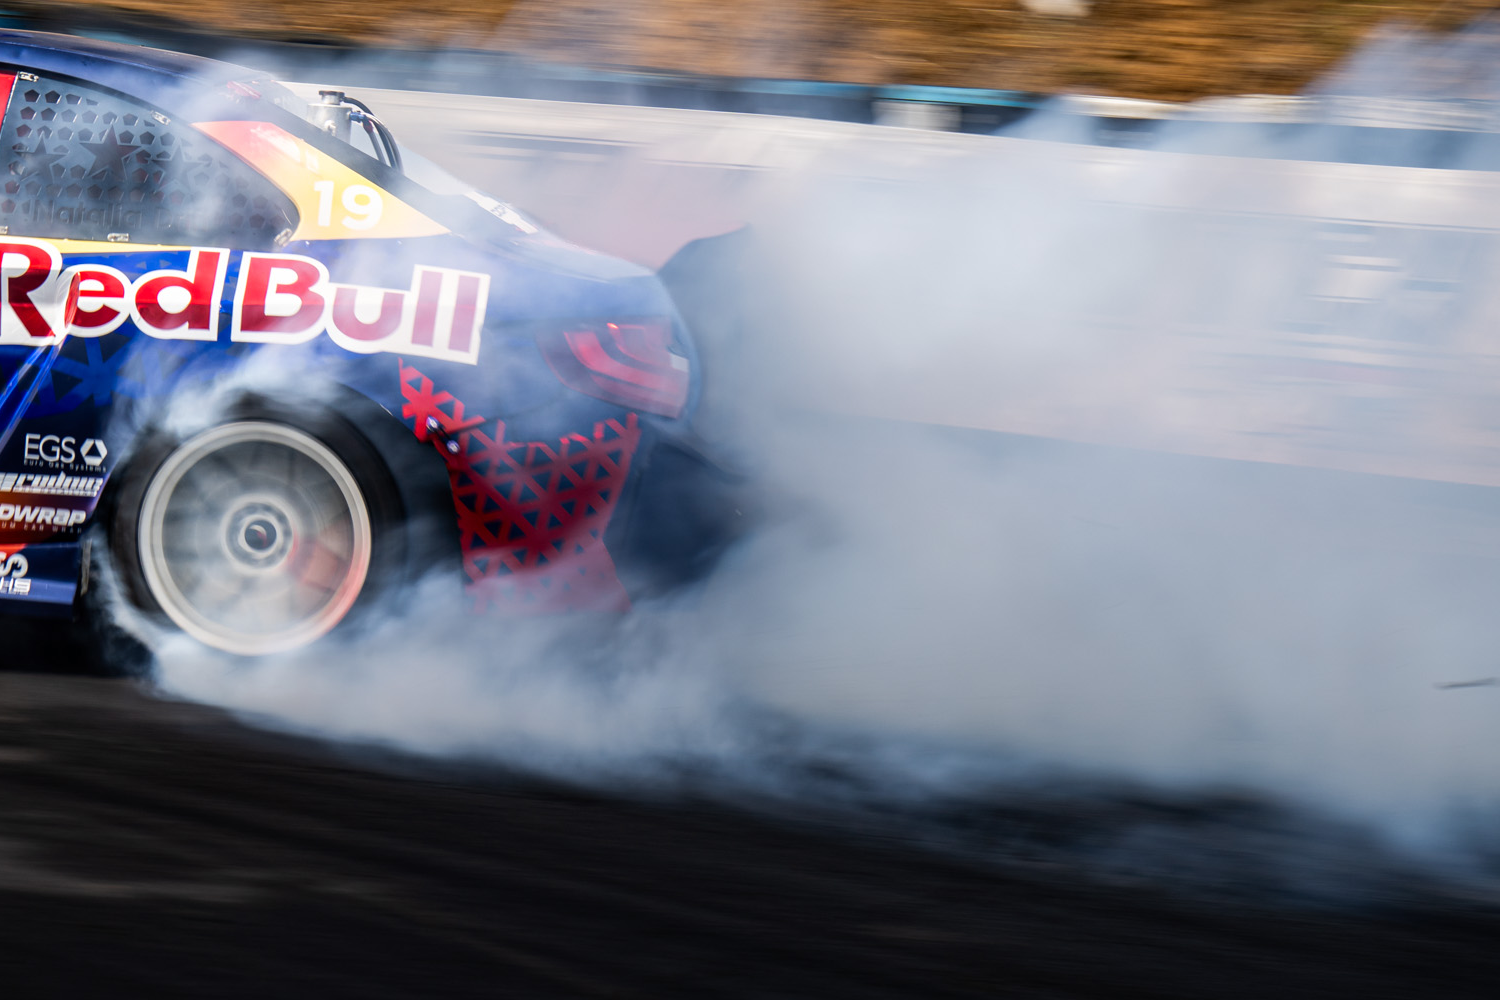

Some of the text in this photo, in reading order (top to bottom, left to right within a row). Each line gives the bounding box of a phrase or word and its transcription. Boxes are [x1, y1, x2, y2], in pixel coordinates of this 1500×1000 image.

[313, 180, 384, 230] 19
[231, 248, 491, 366] Bull
[24, 433, 76, 463] EGS
